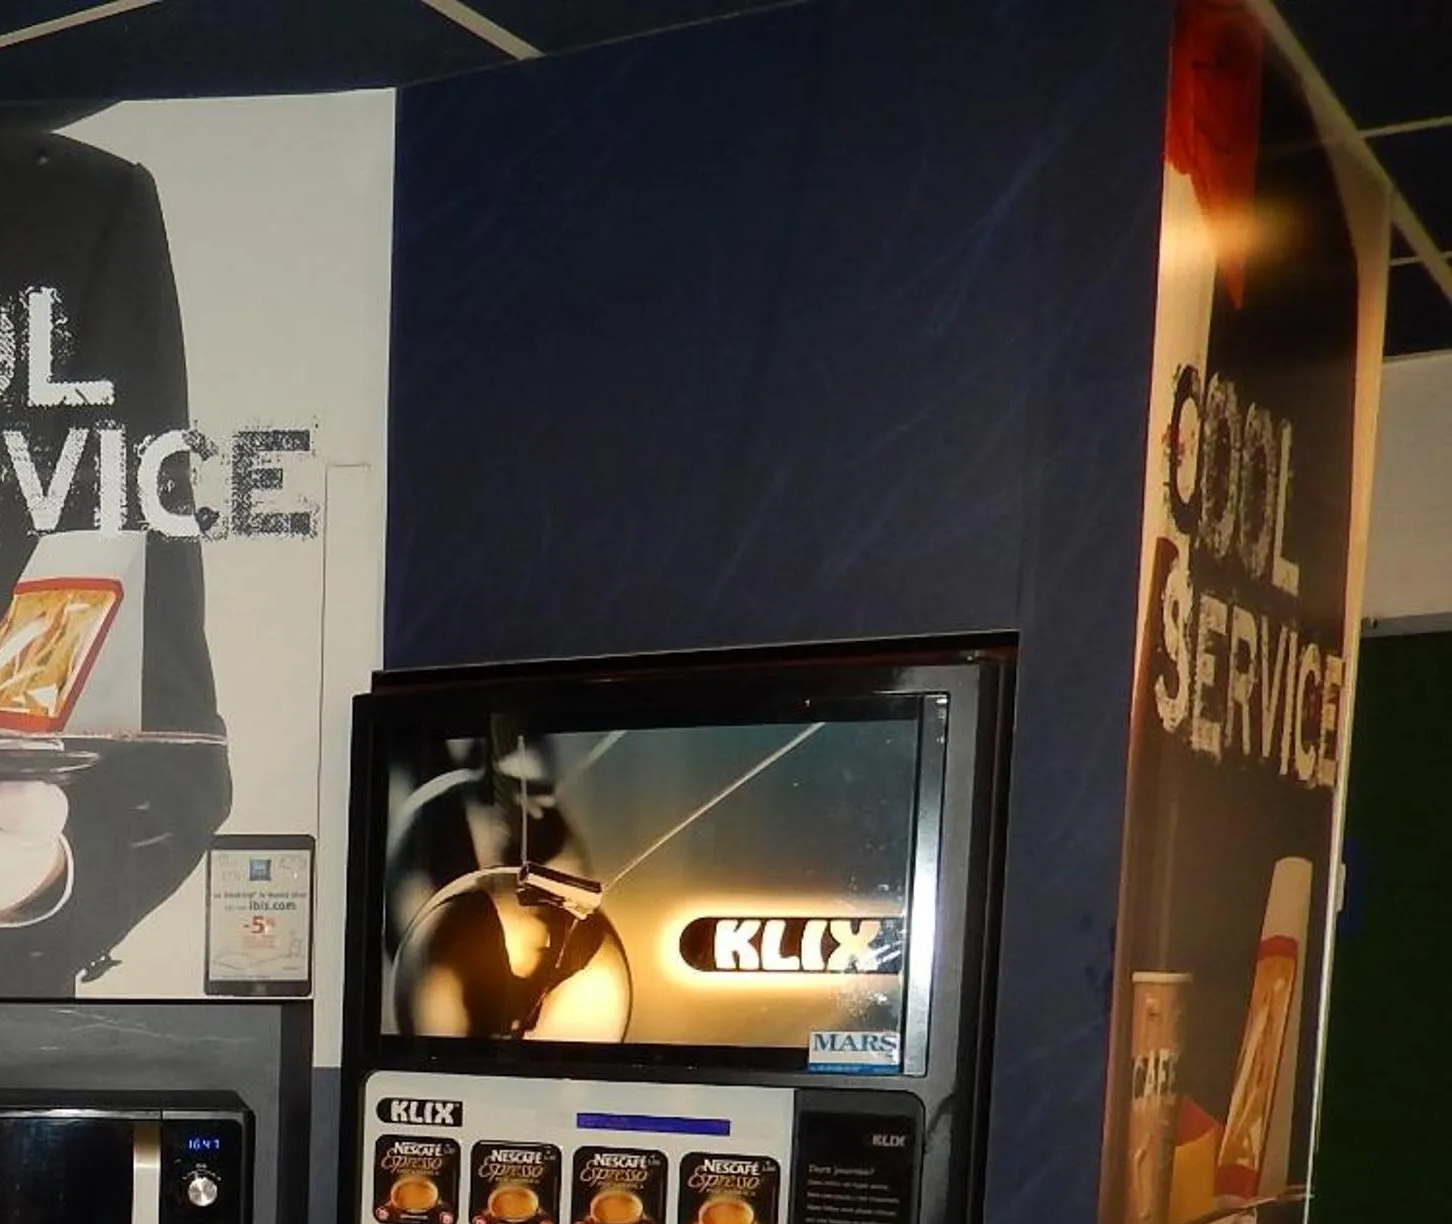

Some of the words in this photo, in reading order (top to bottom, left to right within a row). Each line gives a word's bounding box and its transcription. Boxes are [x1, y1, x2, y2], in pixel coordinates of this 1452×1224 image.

[1163, 365, 1300, 597] COOL
[1154, 554, 1345, 788] SERVICE
[249, 900, 296, 911] ibis.com
[712, 919, 880, 971] KLIX
[813, 1033, 898, 1052] MARS
[390, 1100, 455, 1124] KLIX
[872, 1134, 907, 1147] KLIX
